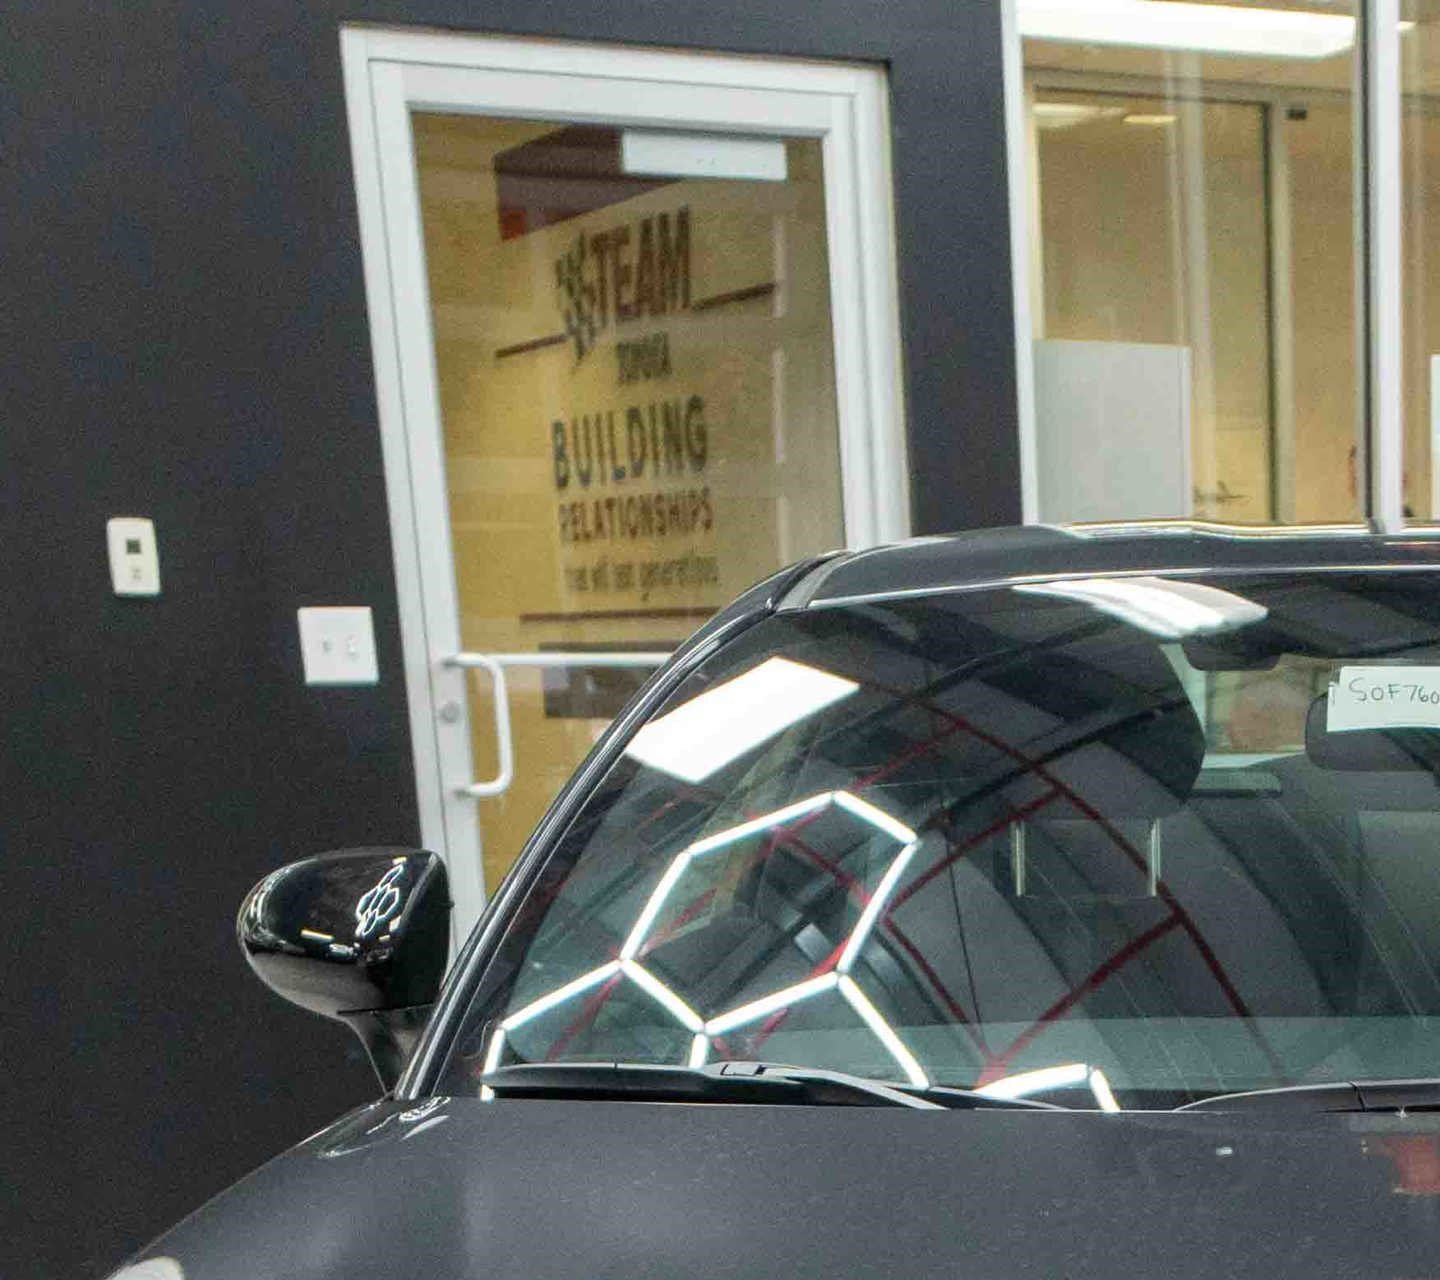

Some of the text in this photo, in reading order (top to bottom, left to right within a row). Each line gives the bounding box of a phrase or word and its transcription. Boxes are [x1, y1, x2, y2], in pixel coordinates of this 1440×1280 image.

[590, 203, 691, 327] TEAM
[552, 394, 708, 491] BUILDING
[559, 487, 713, 542] RELATIONSHIPS
